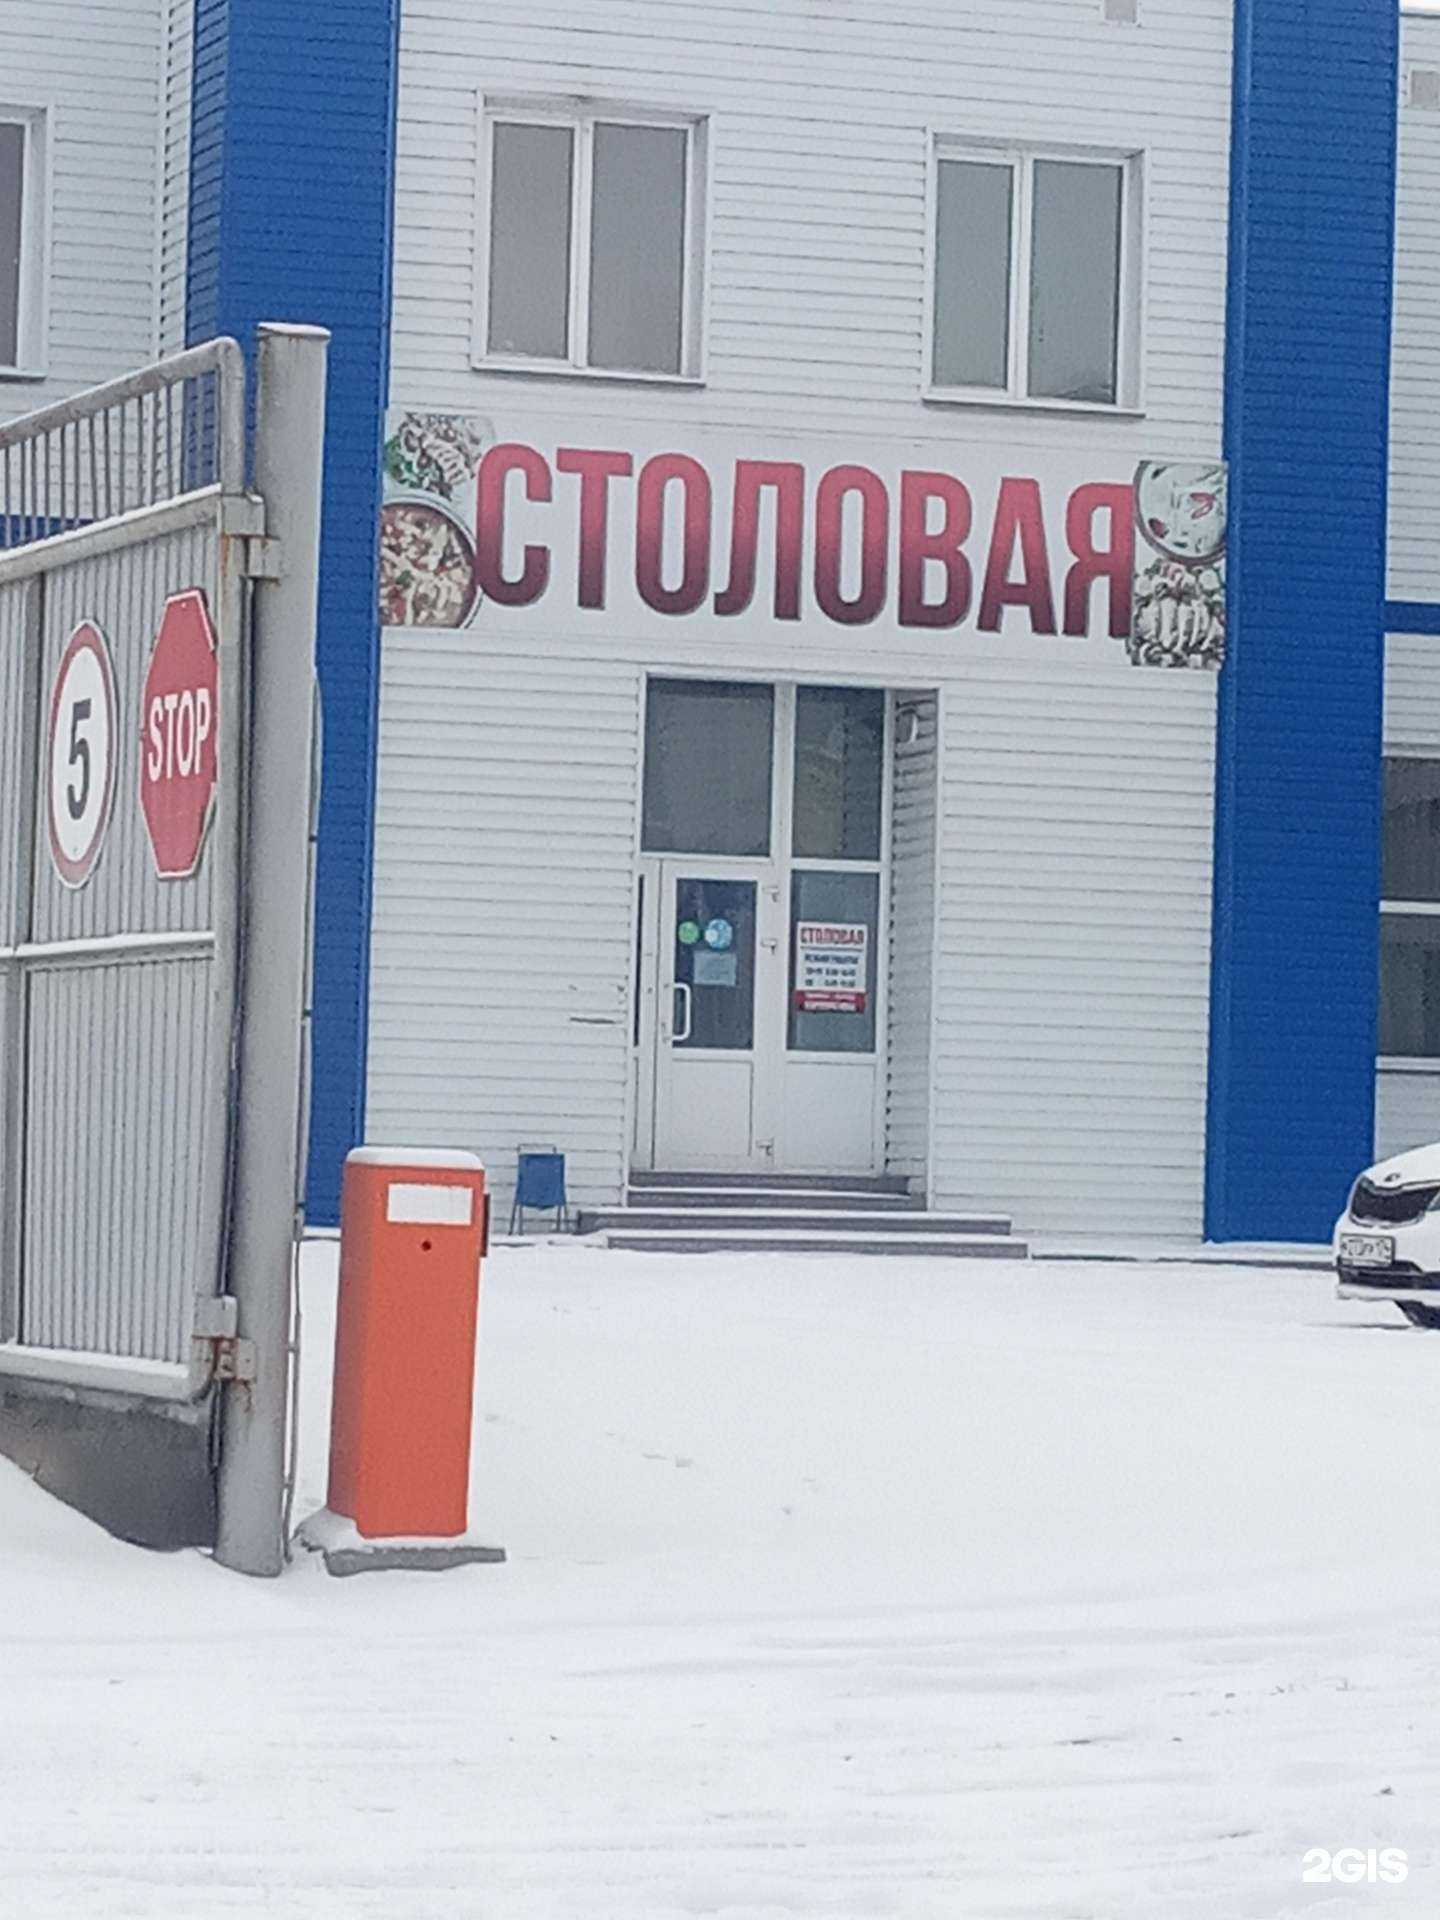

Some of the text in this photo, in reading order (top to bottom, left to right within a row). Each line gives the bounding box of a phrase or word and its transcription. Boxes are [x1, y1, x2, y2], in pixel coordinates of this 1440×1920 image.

[476, 443, 1135, 639] СТОЛОВАЯ
[67, 698, 92, 820] 5
[149, 688, 211, 781] STOP
